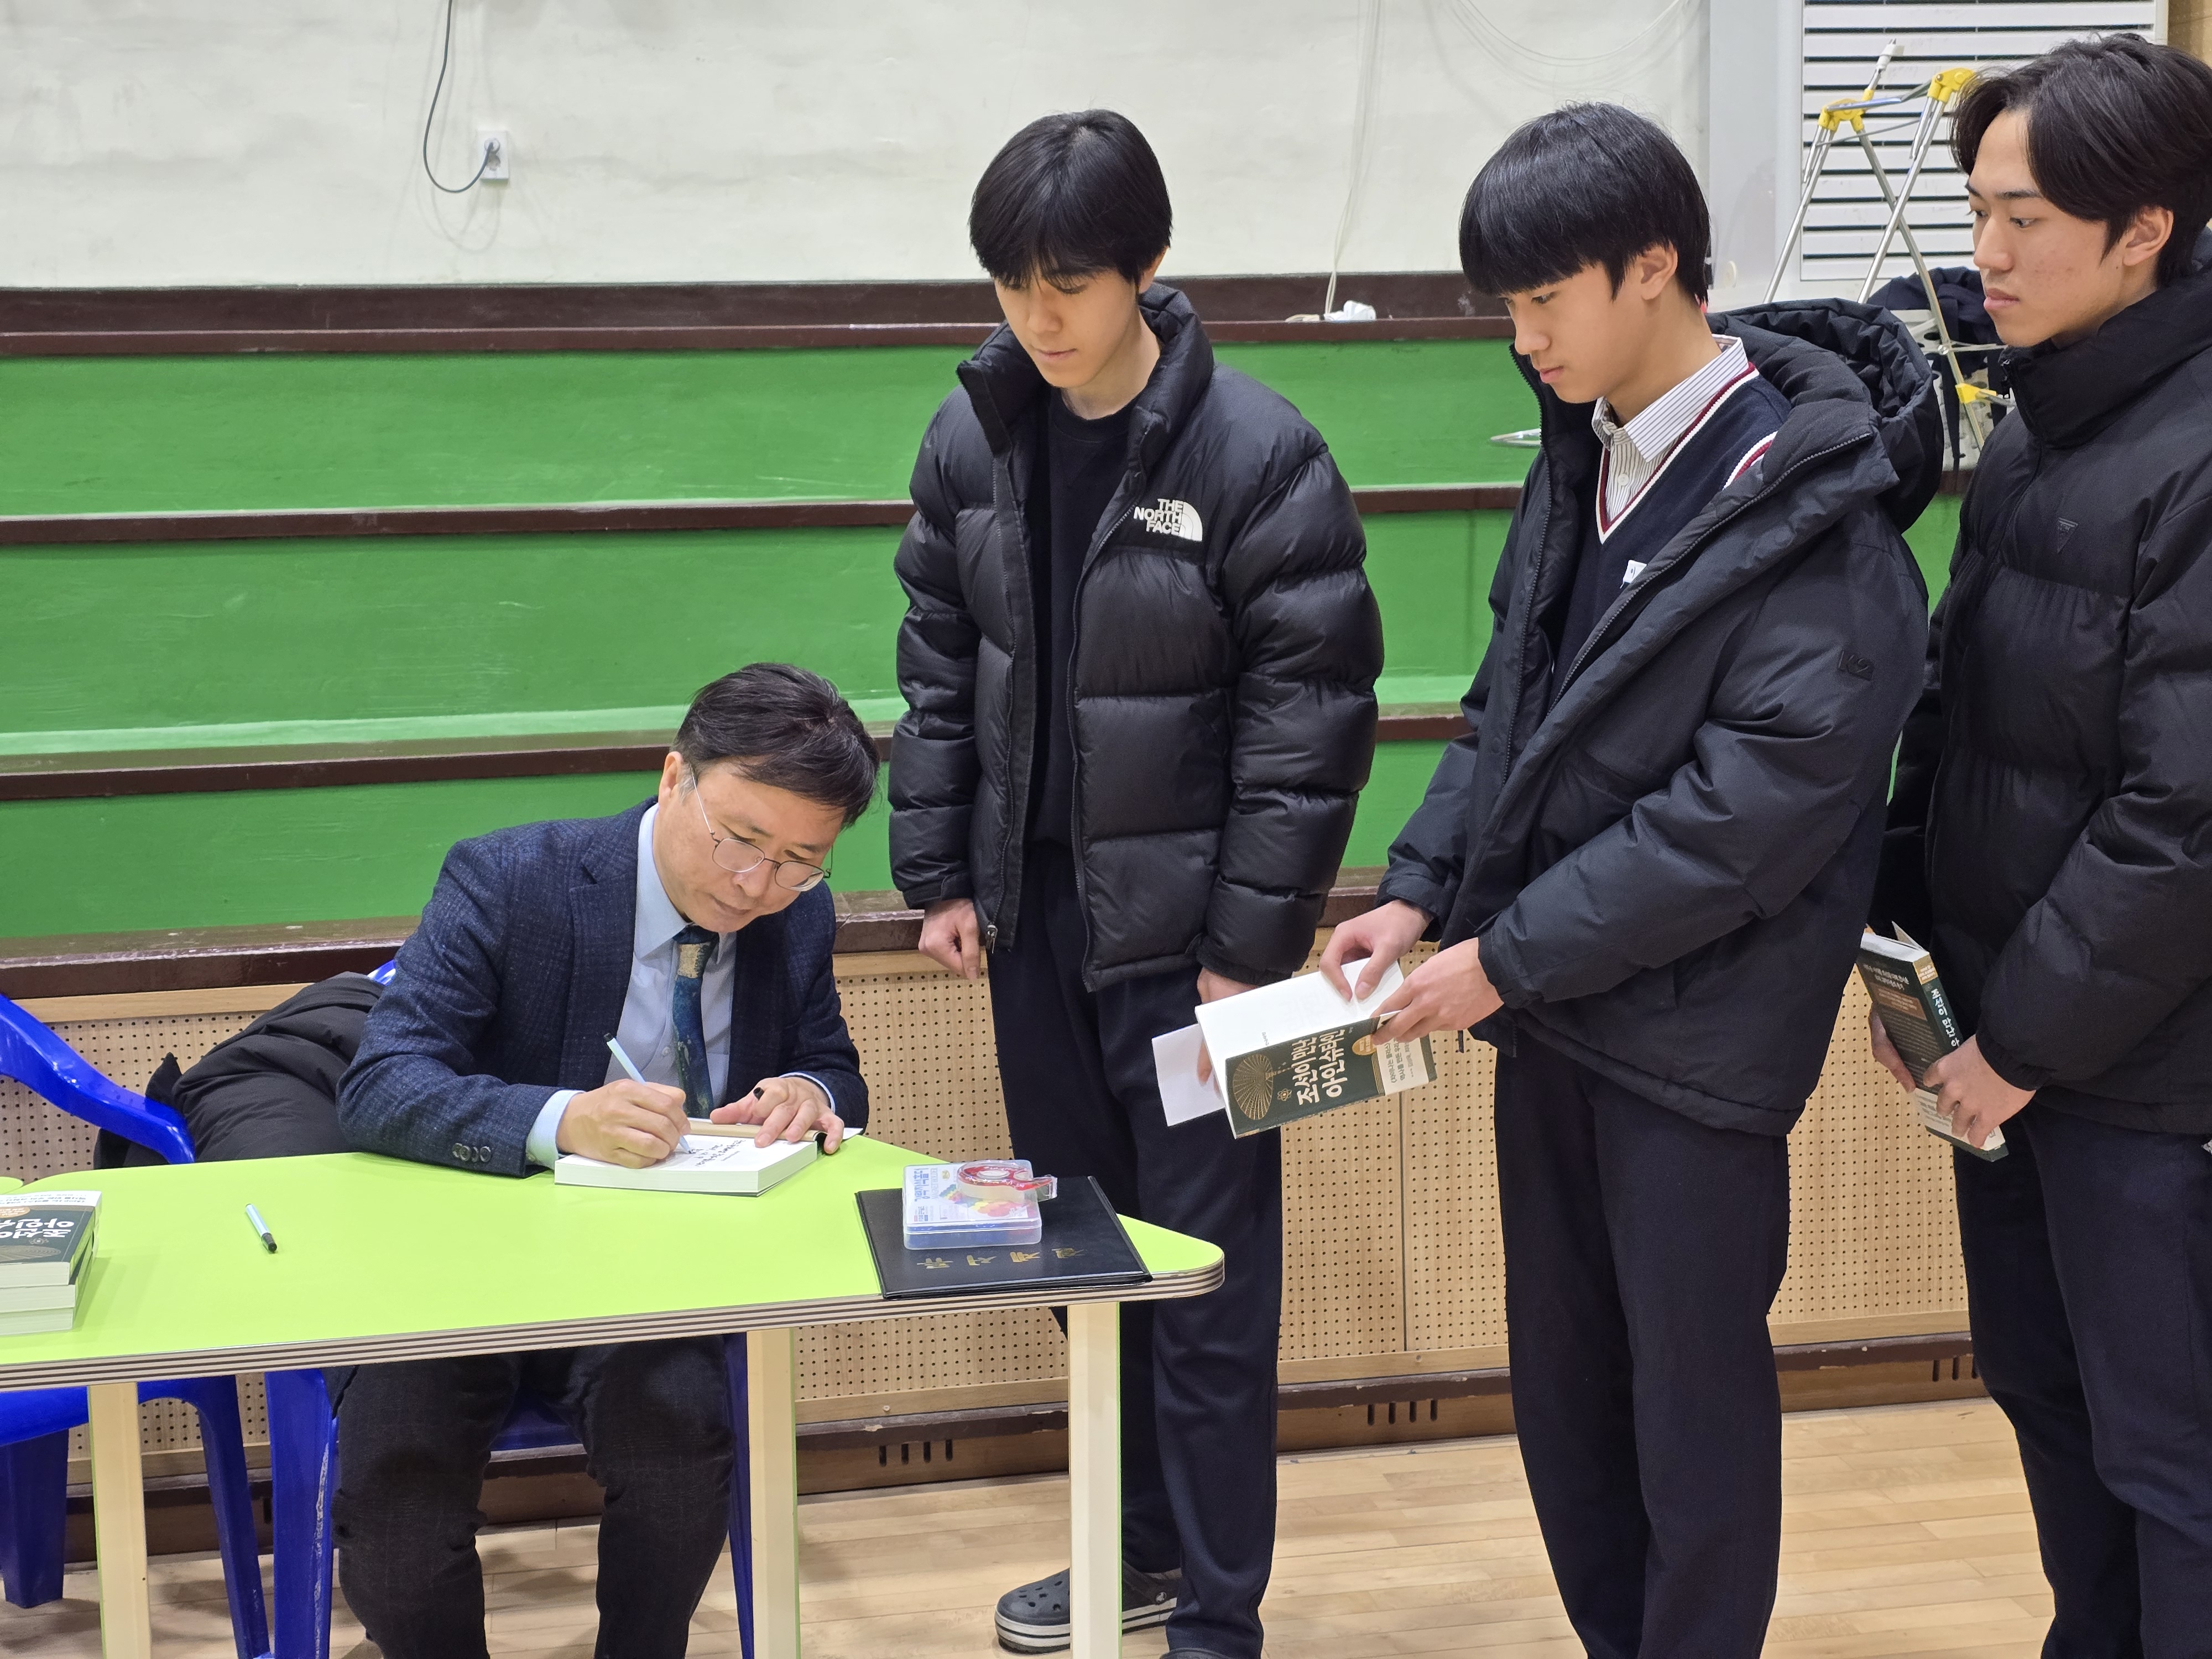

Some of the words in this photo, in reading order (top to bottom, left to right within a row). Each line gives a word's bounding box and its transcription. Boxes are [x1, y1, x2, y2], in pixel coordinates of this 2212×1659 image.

[1133, 506, 1182, 523] NORTH
[1157, 498, 1183, 512] THE
[1146, 520, 1180, 535] FACE
[1838, 649, 1875, 681] K2
[1931, 988, 1948, 1015] 조선이
[1942, 1018, 1955, 1037] 만난
[1291, 1037, 1317, 1060] 만난
[1318, 1030, 1348, 1098] 아인슈타인
[1291, 1057, 1320, 1105] 조선이
